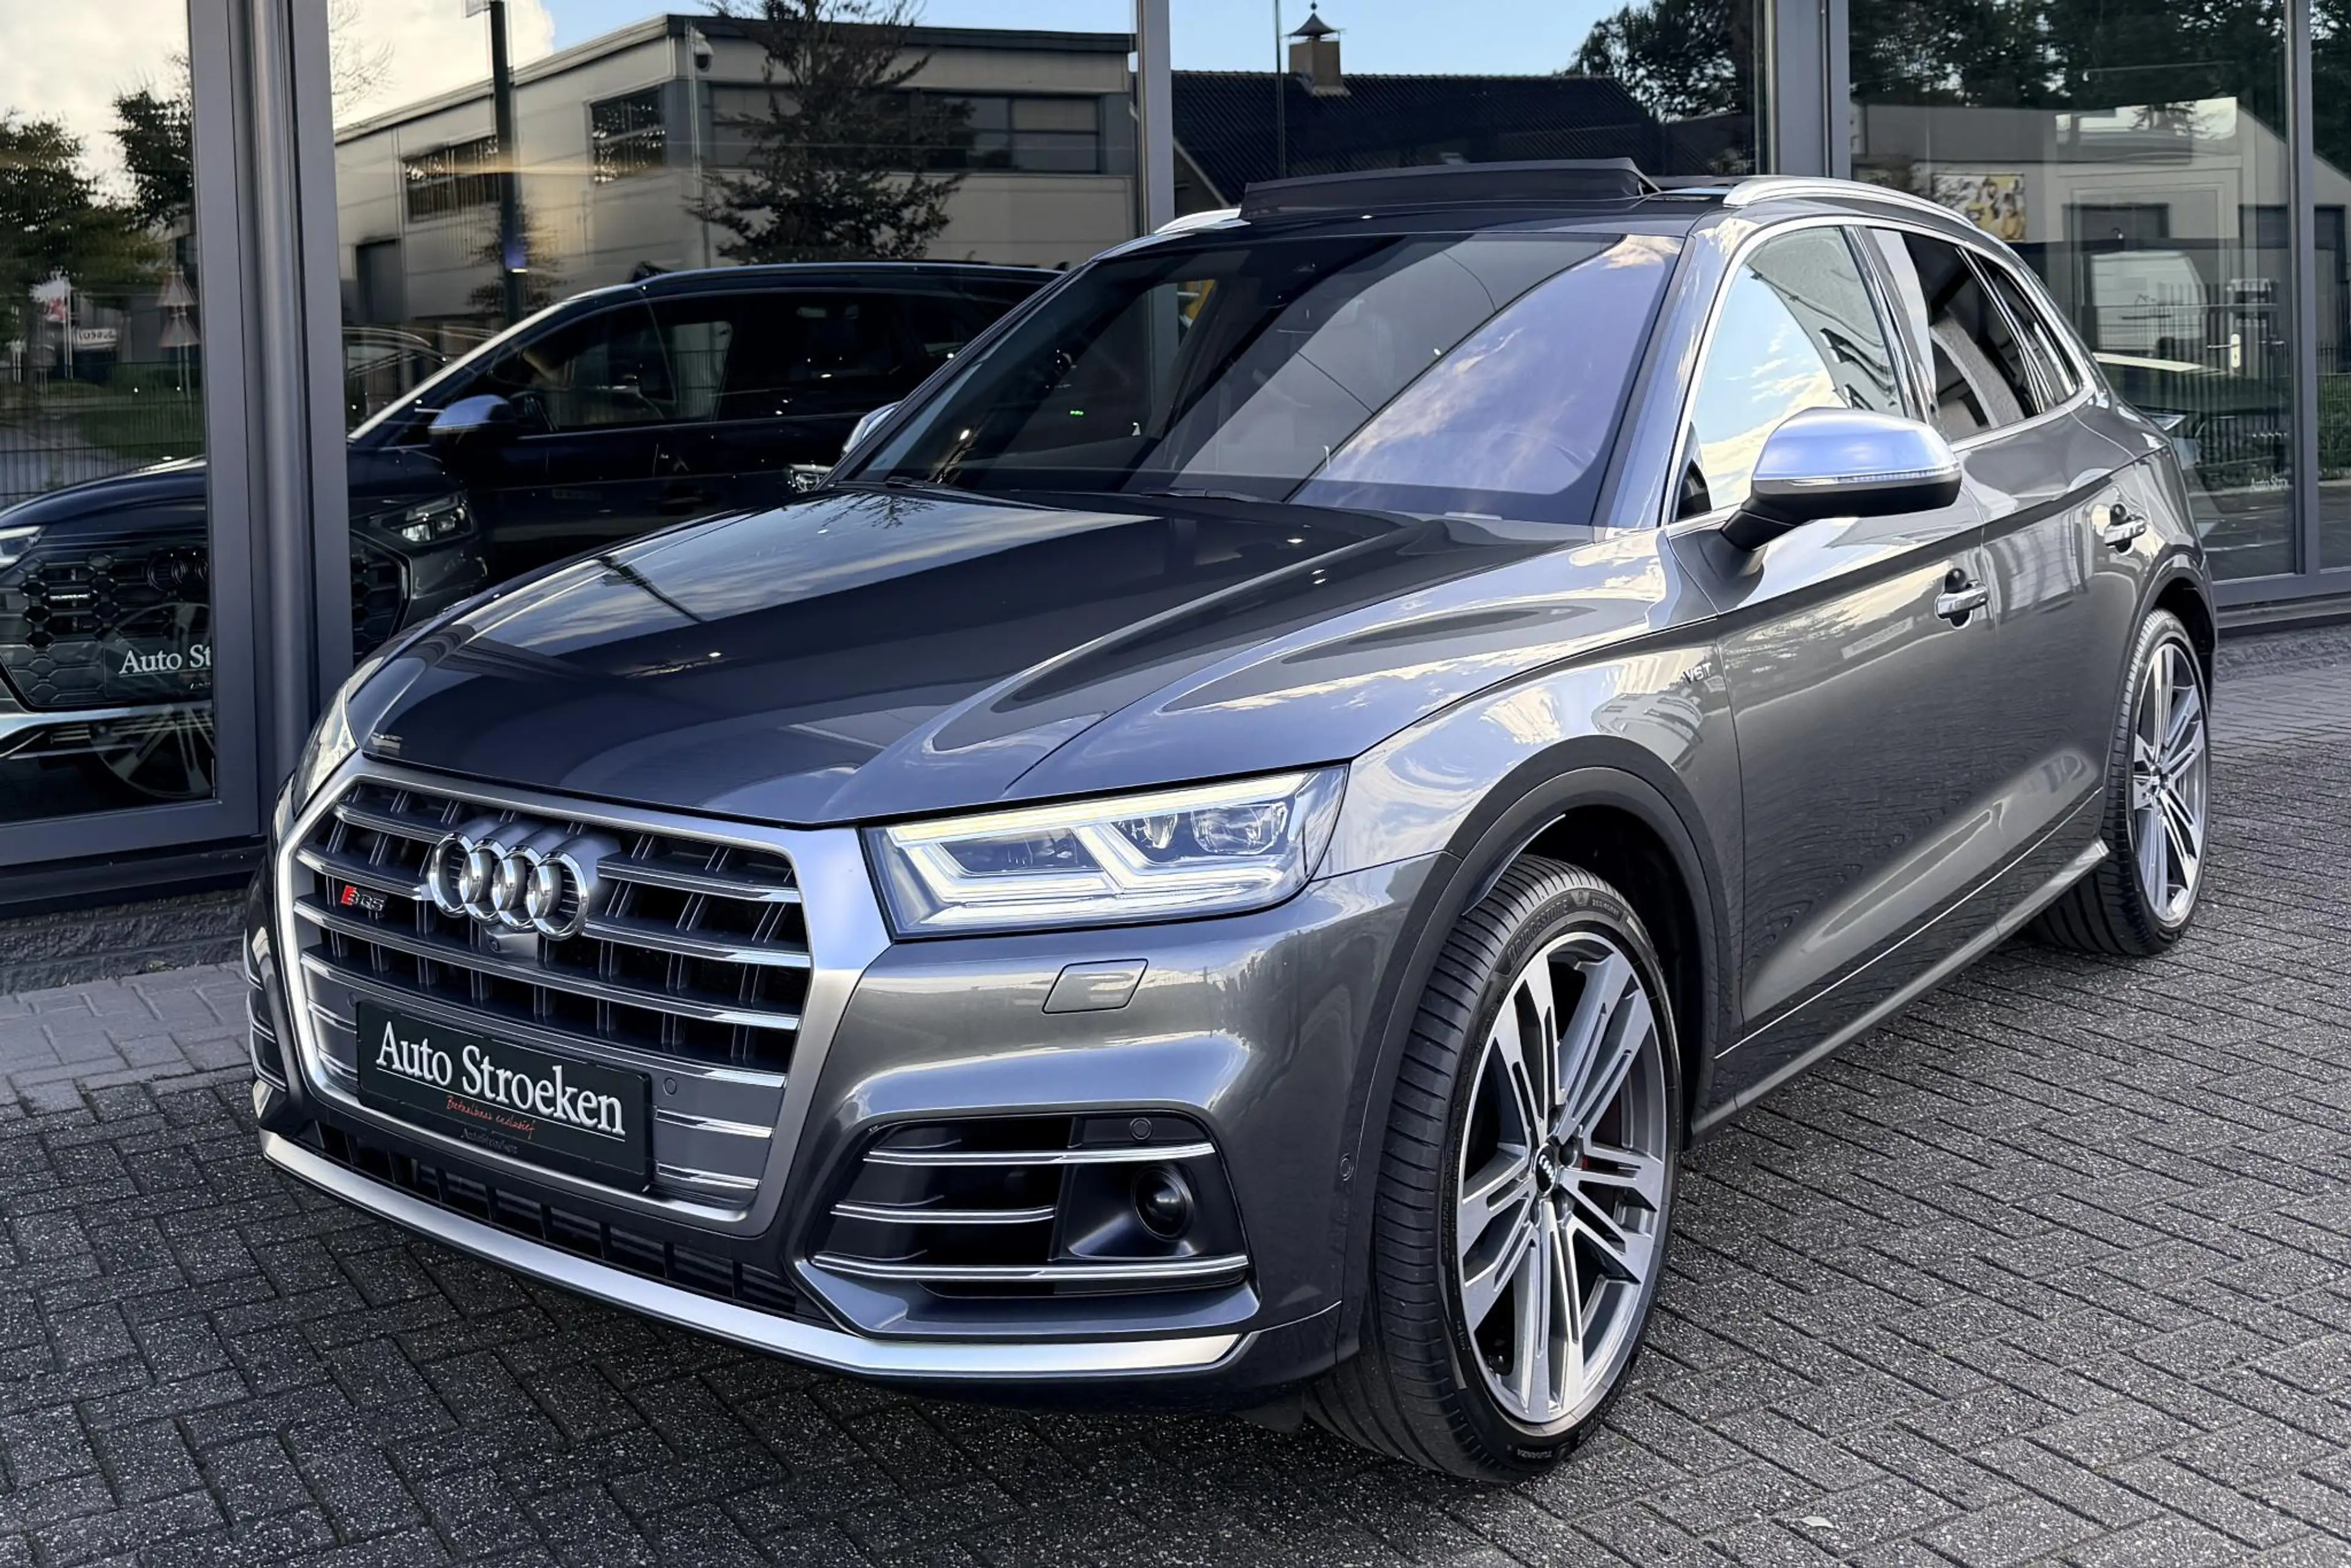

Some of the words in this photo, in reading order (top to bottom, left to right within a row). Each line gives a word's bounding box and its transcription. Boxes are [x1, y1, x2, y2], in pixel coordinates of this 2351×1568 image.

[119, 650, 182, 675] Auto
[341, 885, 385, 912] SQ5
[376, 1021, 453, 1086] Auto
[462, 1045, 626, 1135] Stroeken
